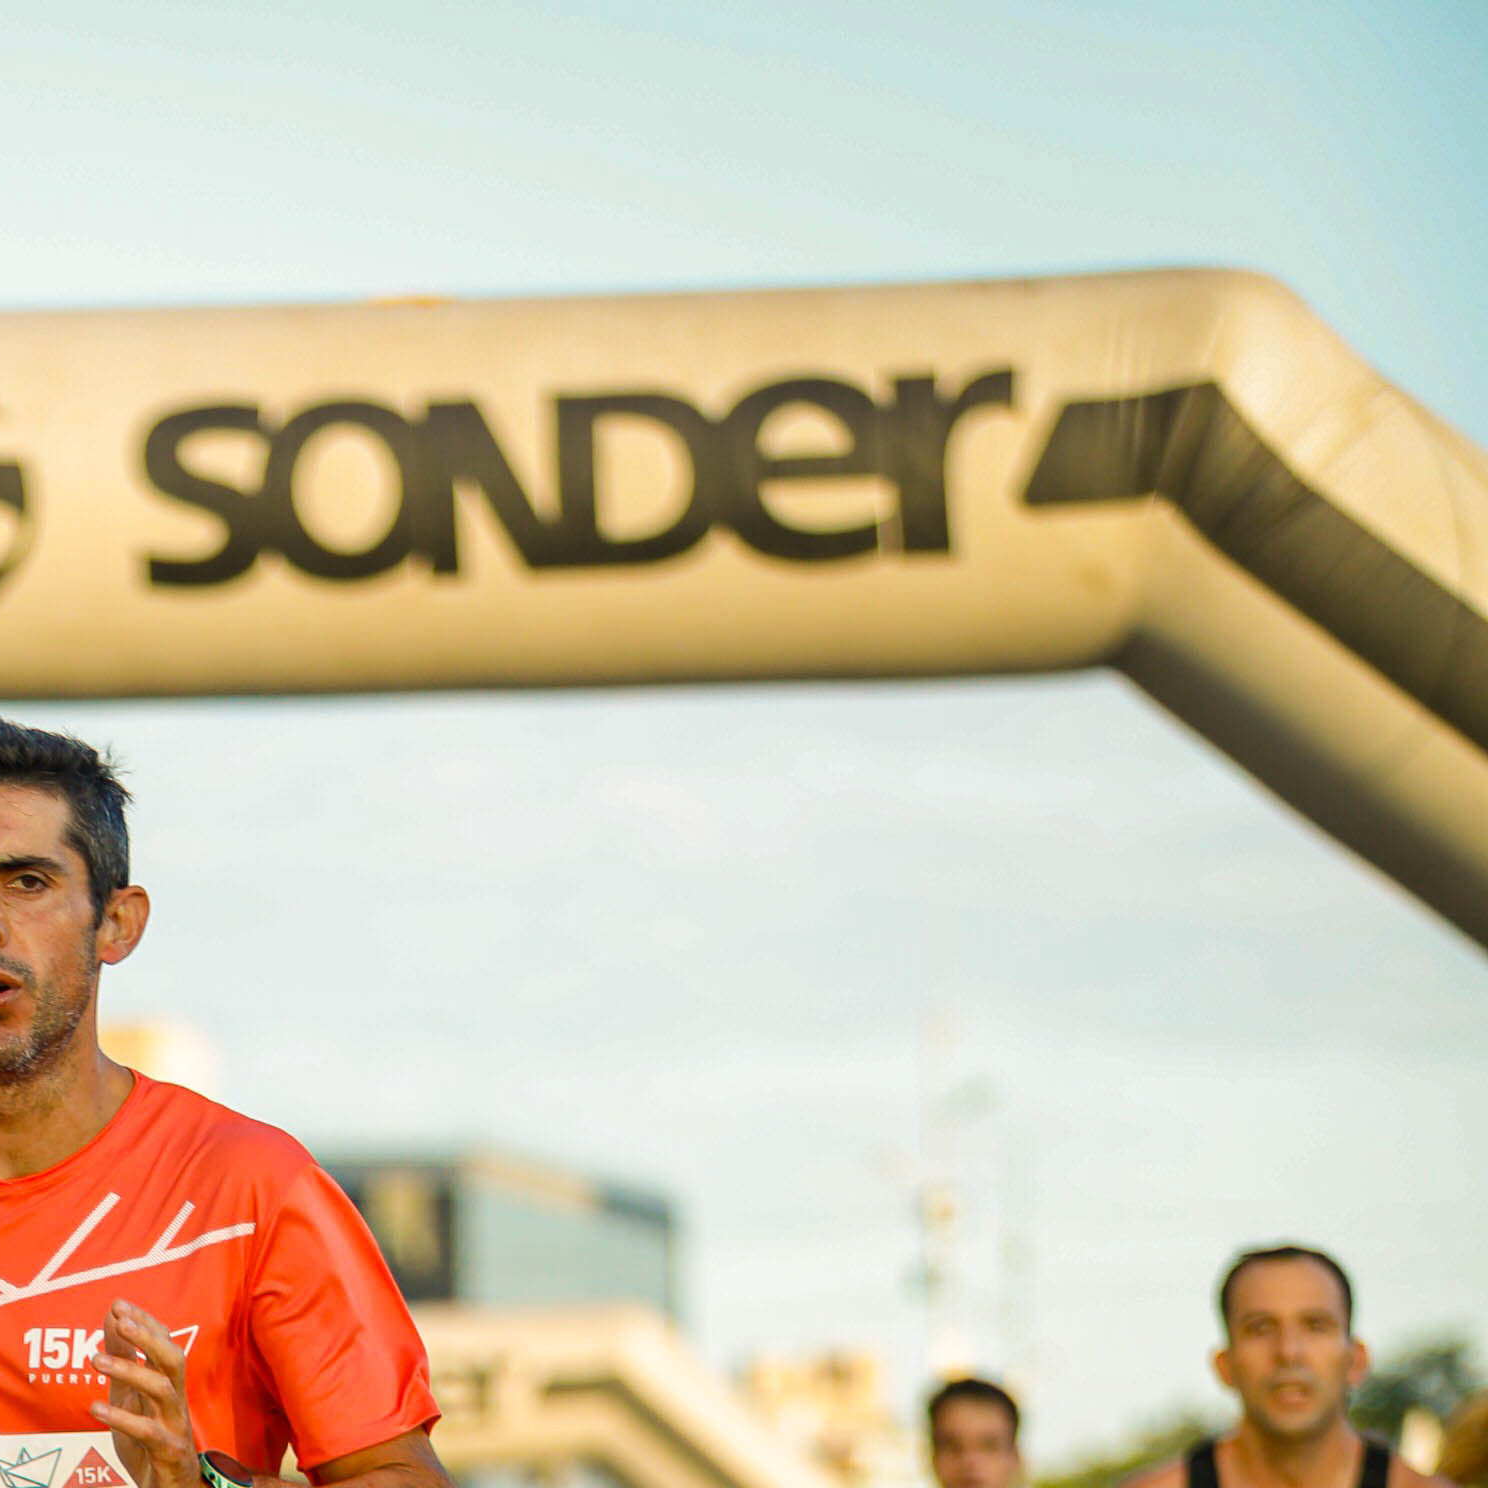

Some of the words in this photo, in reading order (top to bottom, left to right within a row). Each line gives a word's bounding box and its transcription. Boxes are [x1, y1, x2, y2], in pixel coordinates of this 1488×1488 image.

[23, 1327, 106, 1370] 15K
[28, 1373, 107, 1385] PUERTO
[75, 1465, 113, 1486] 15K
